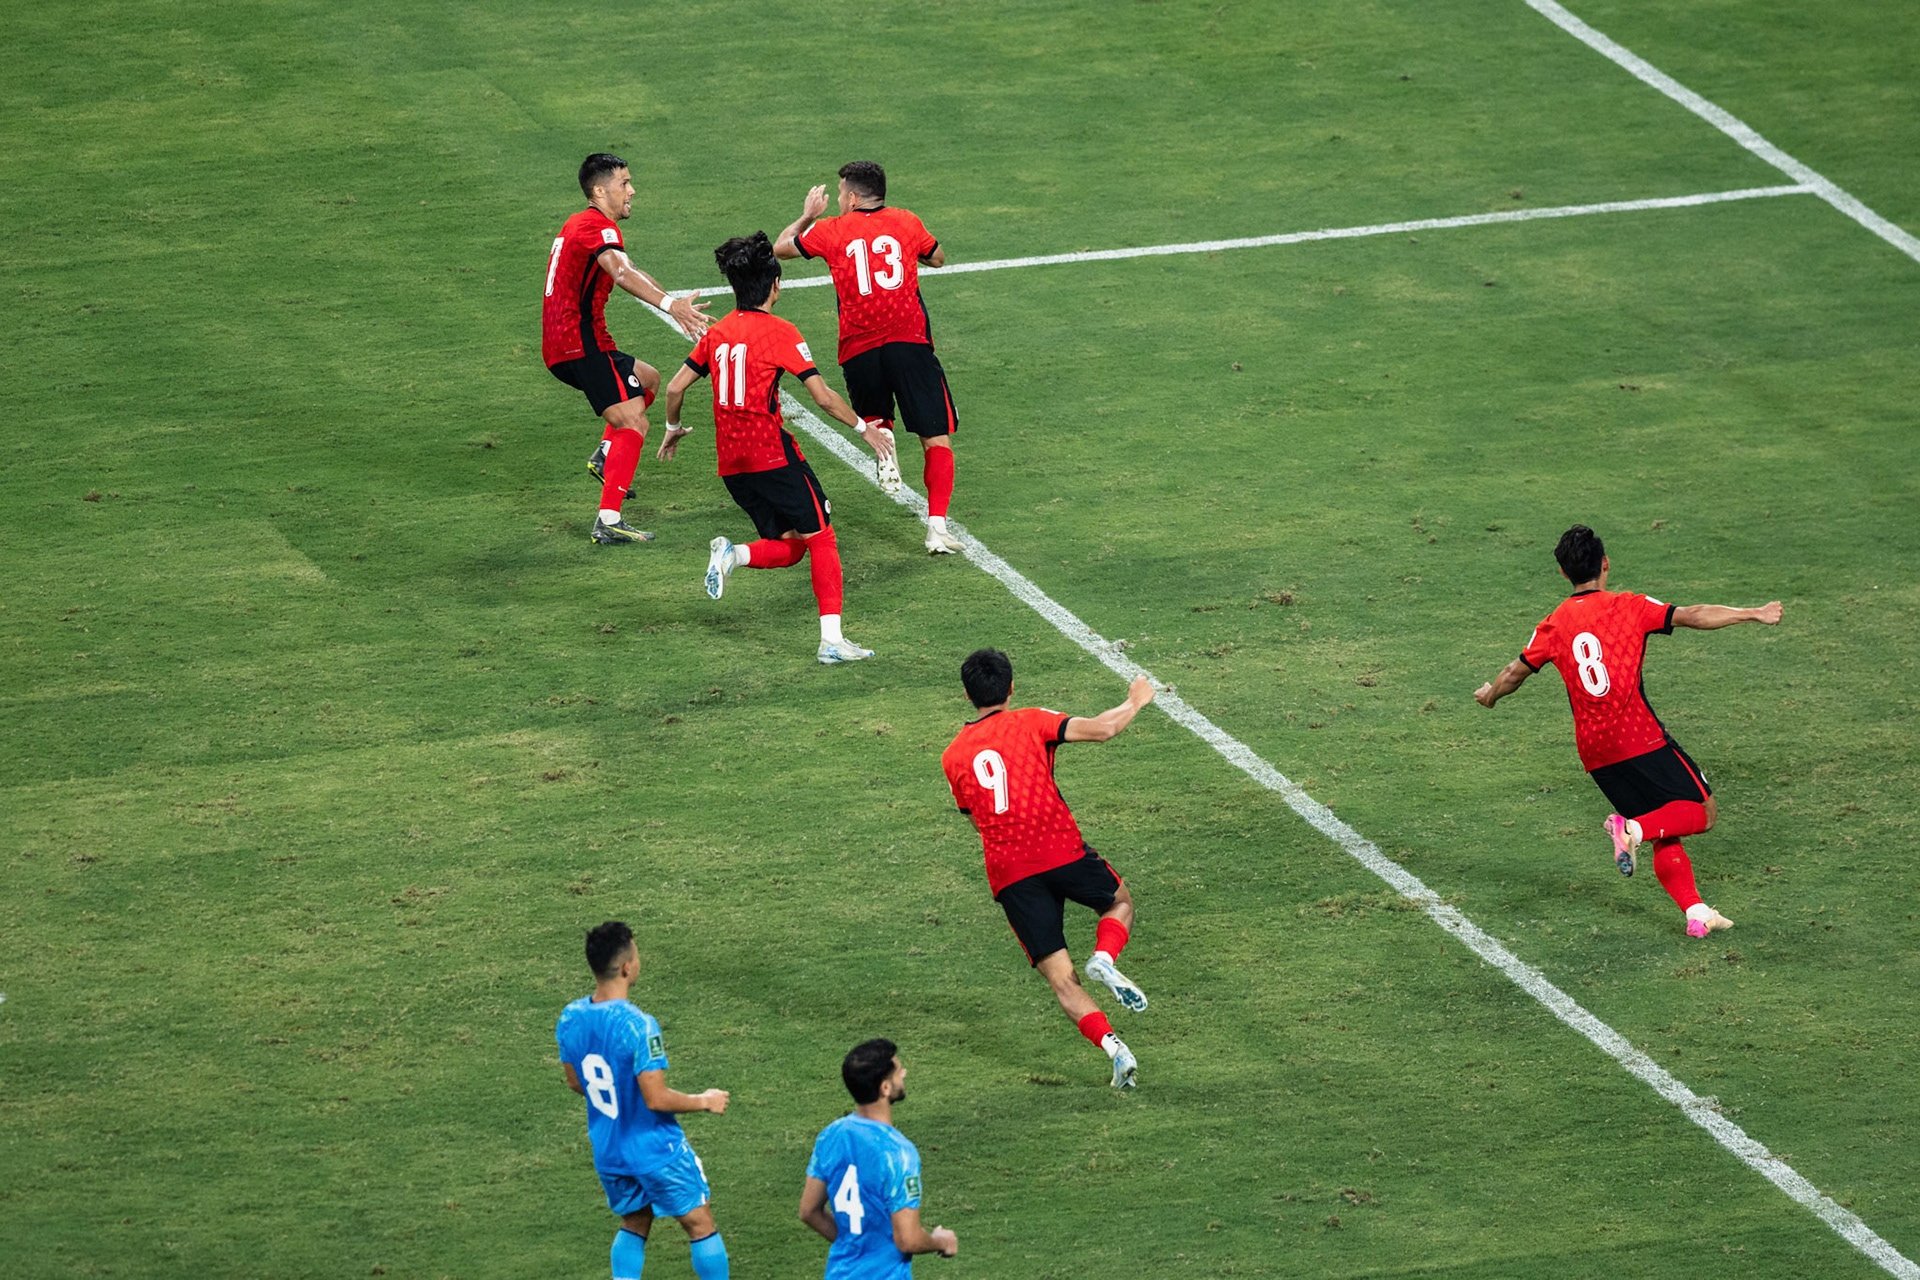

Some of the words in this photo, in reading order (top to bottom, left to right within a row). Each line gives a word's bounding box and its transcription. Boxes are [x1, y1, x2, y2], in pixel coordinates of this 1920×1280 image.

[846, 235, 904, 296] 13
[715, 343, 747, 406] 11
[1572, 632, 1610, 697] 8
[973, 749, 1009, 814] 9
[581, 1053, 619, 1120] 8
[834, 1164, 865, 1235] 4
